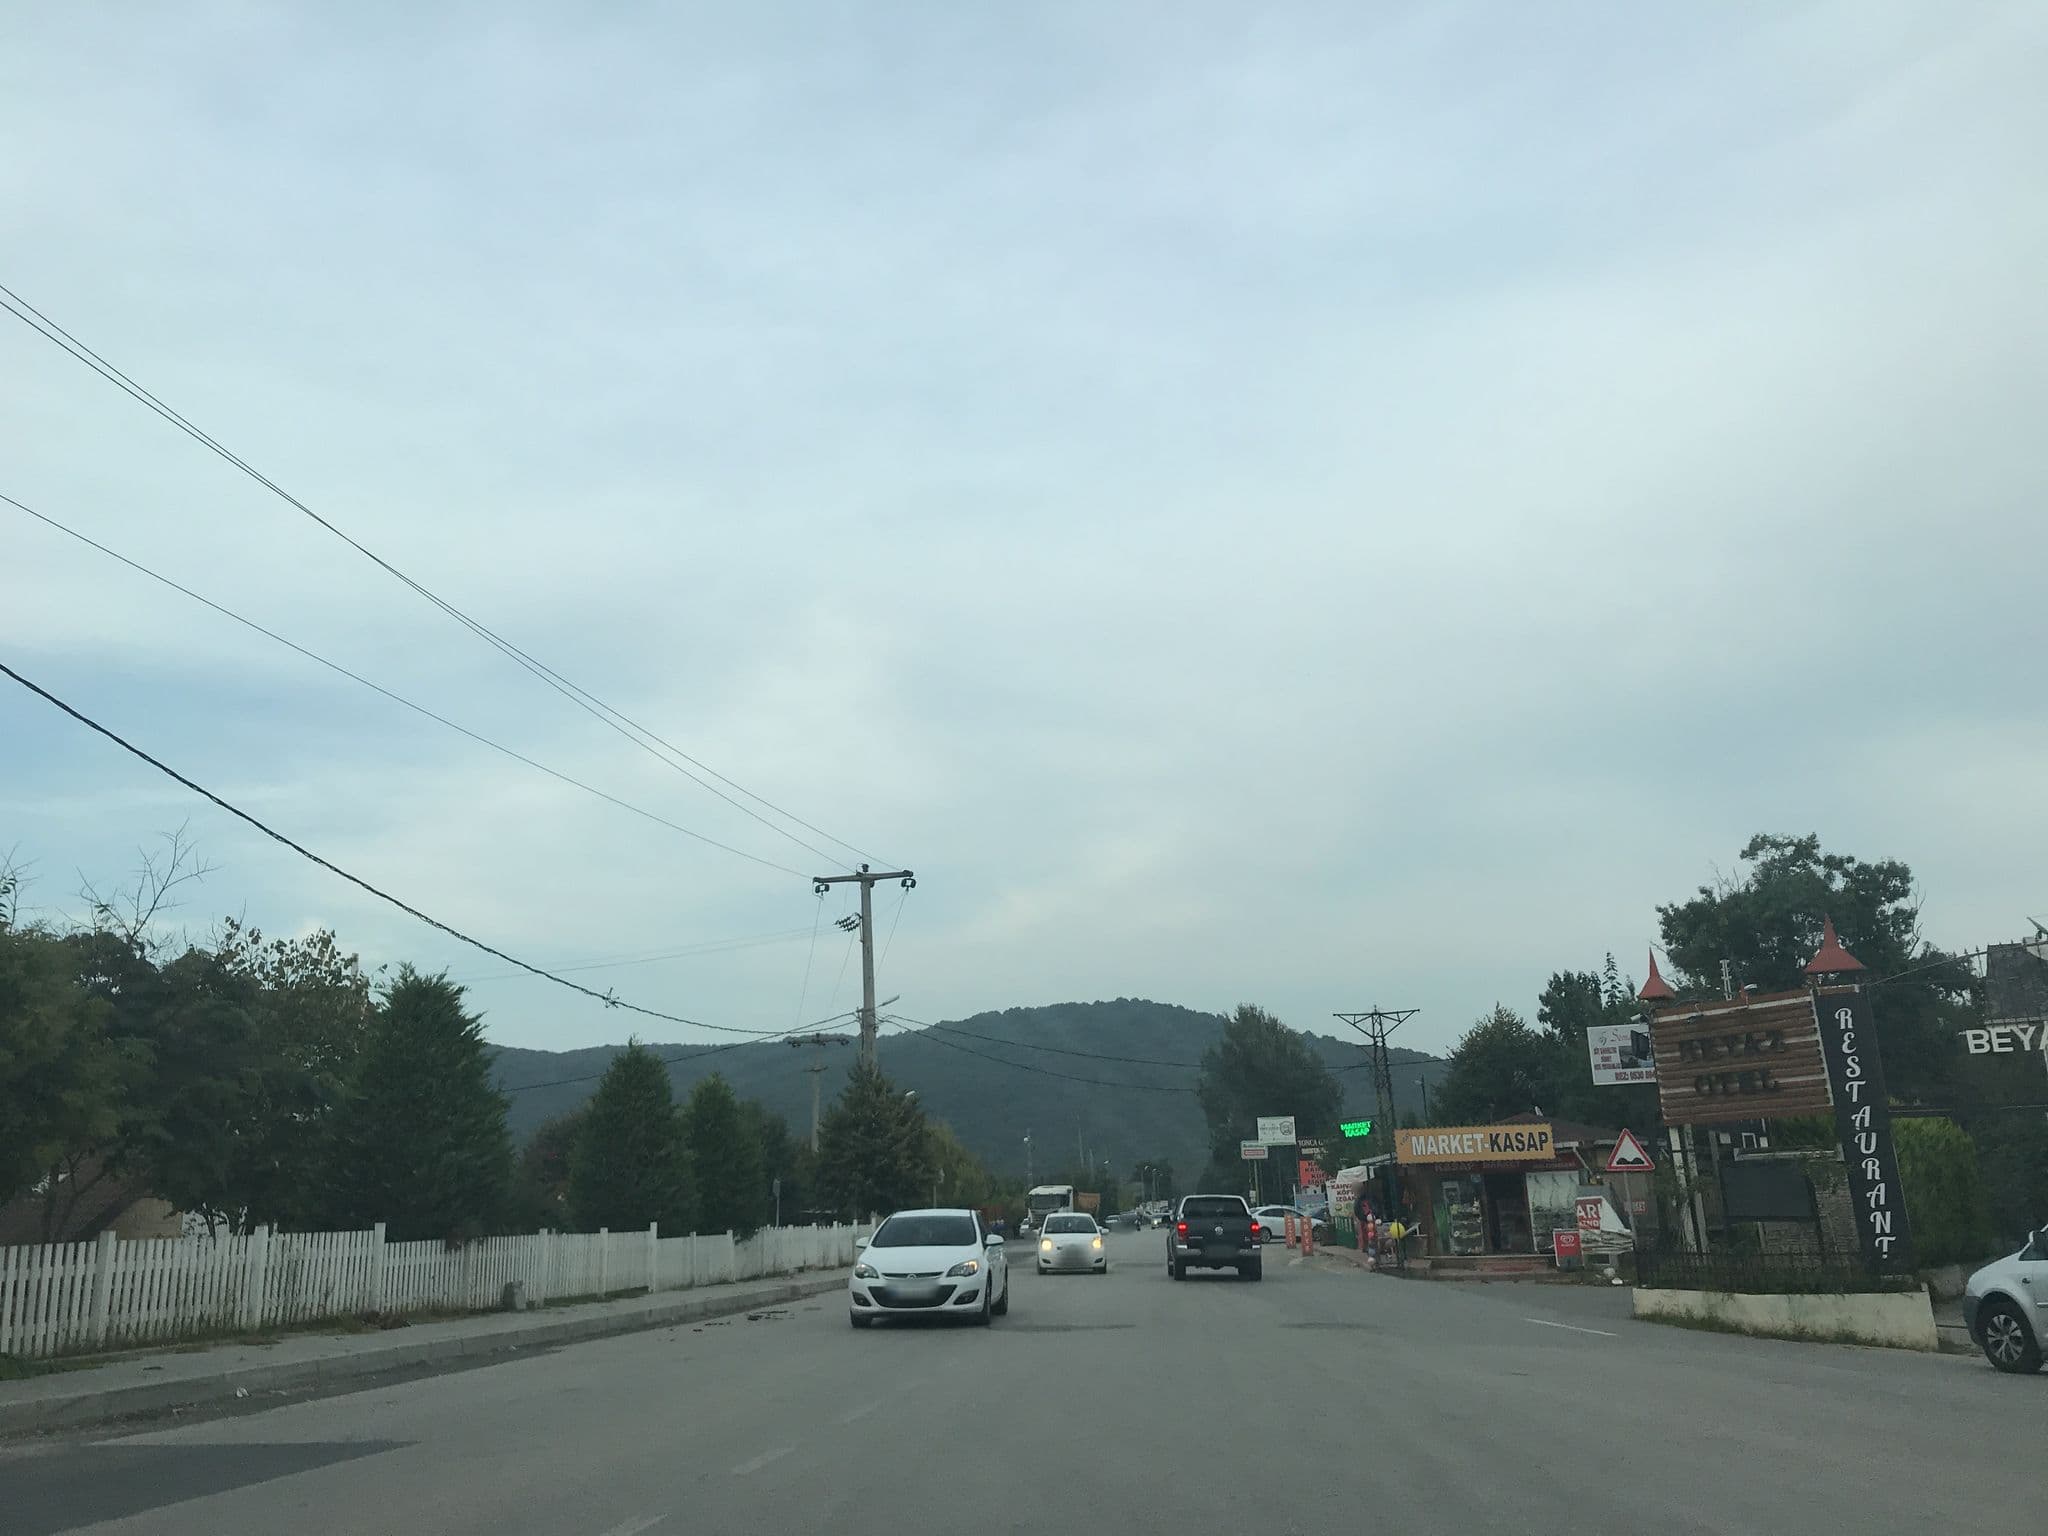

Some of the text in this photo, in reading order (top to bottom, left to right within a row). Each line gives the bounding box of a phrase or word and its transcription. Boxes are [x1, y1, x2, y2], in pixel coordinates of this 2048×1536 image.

[1340, 1120, 1371, 1131] MARKET
[1344, 1127, 1370, 1138] KASAP
[1834, 1007, 1896, 1259] RESTAURANT
